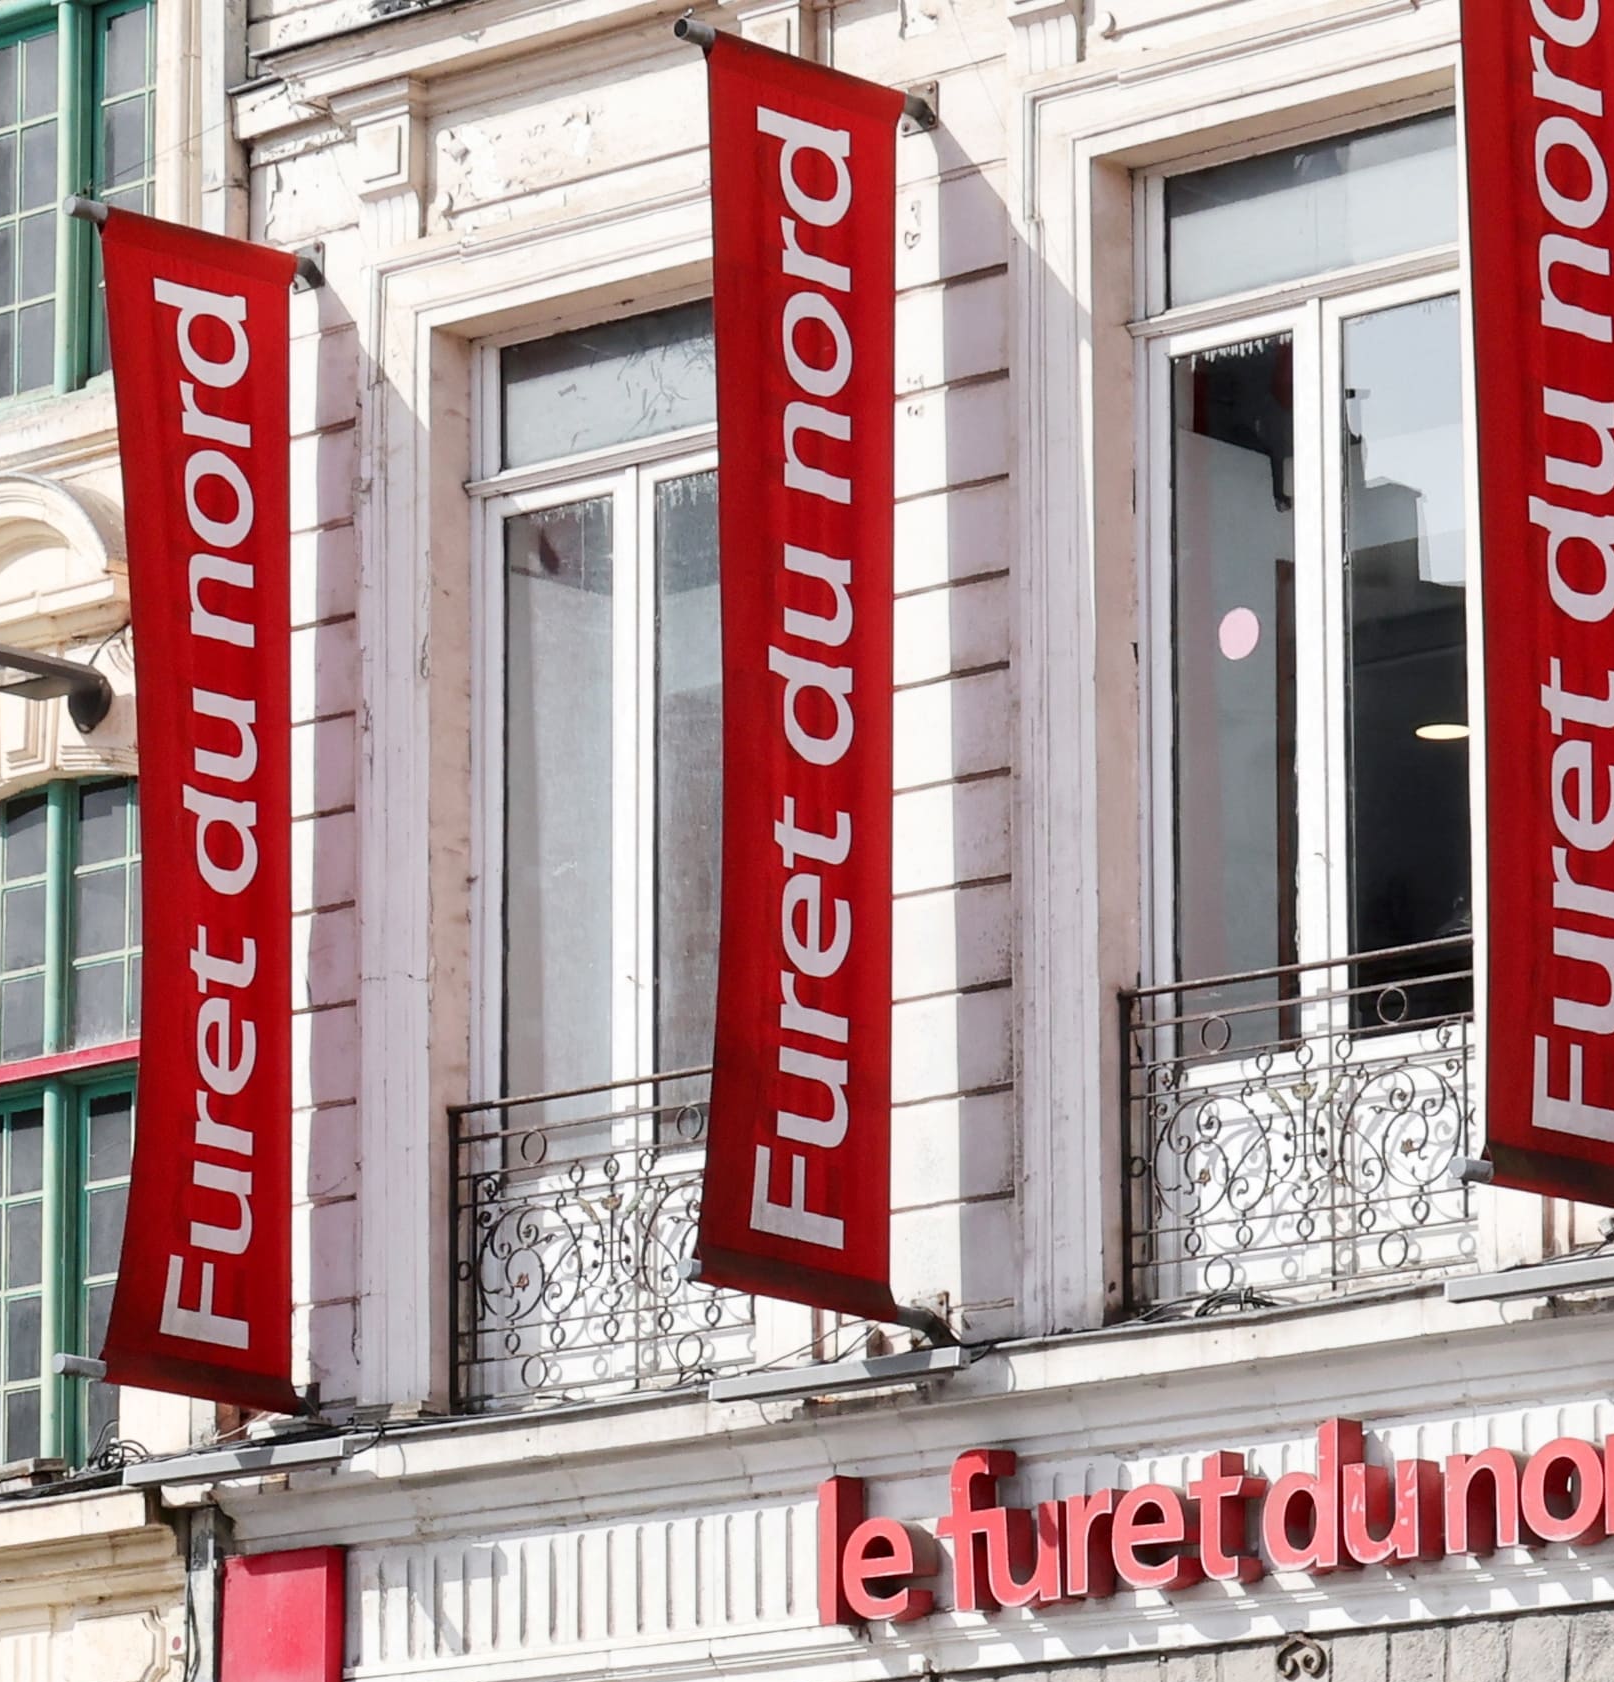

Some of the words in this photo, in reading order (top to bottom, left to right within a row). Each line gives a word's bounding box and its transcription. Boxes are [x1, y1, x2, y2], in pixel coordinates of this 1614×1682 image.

[153, 277, 254, 648] nord
[756, 105, 852, 505] nord
[182, 687, 258, 896] du
[768, 542, 854, 766] du
[159, 925, 257, 1350] Furet
[749, 795, 852, 1250] Furet
[818, 1475, 933, 1626] le
[936, 1449, 1265, 1612] furet
